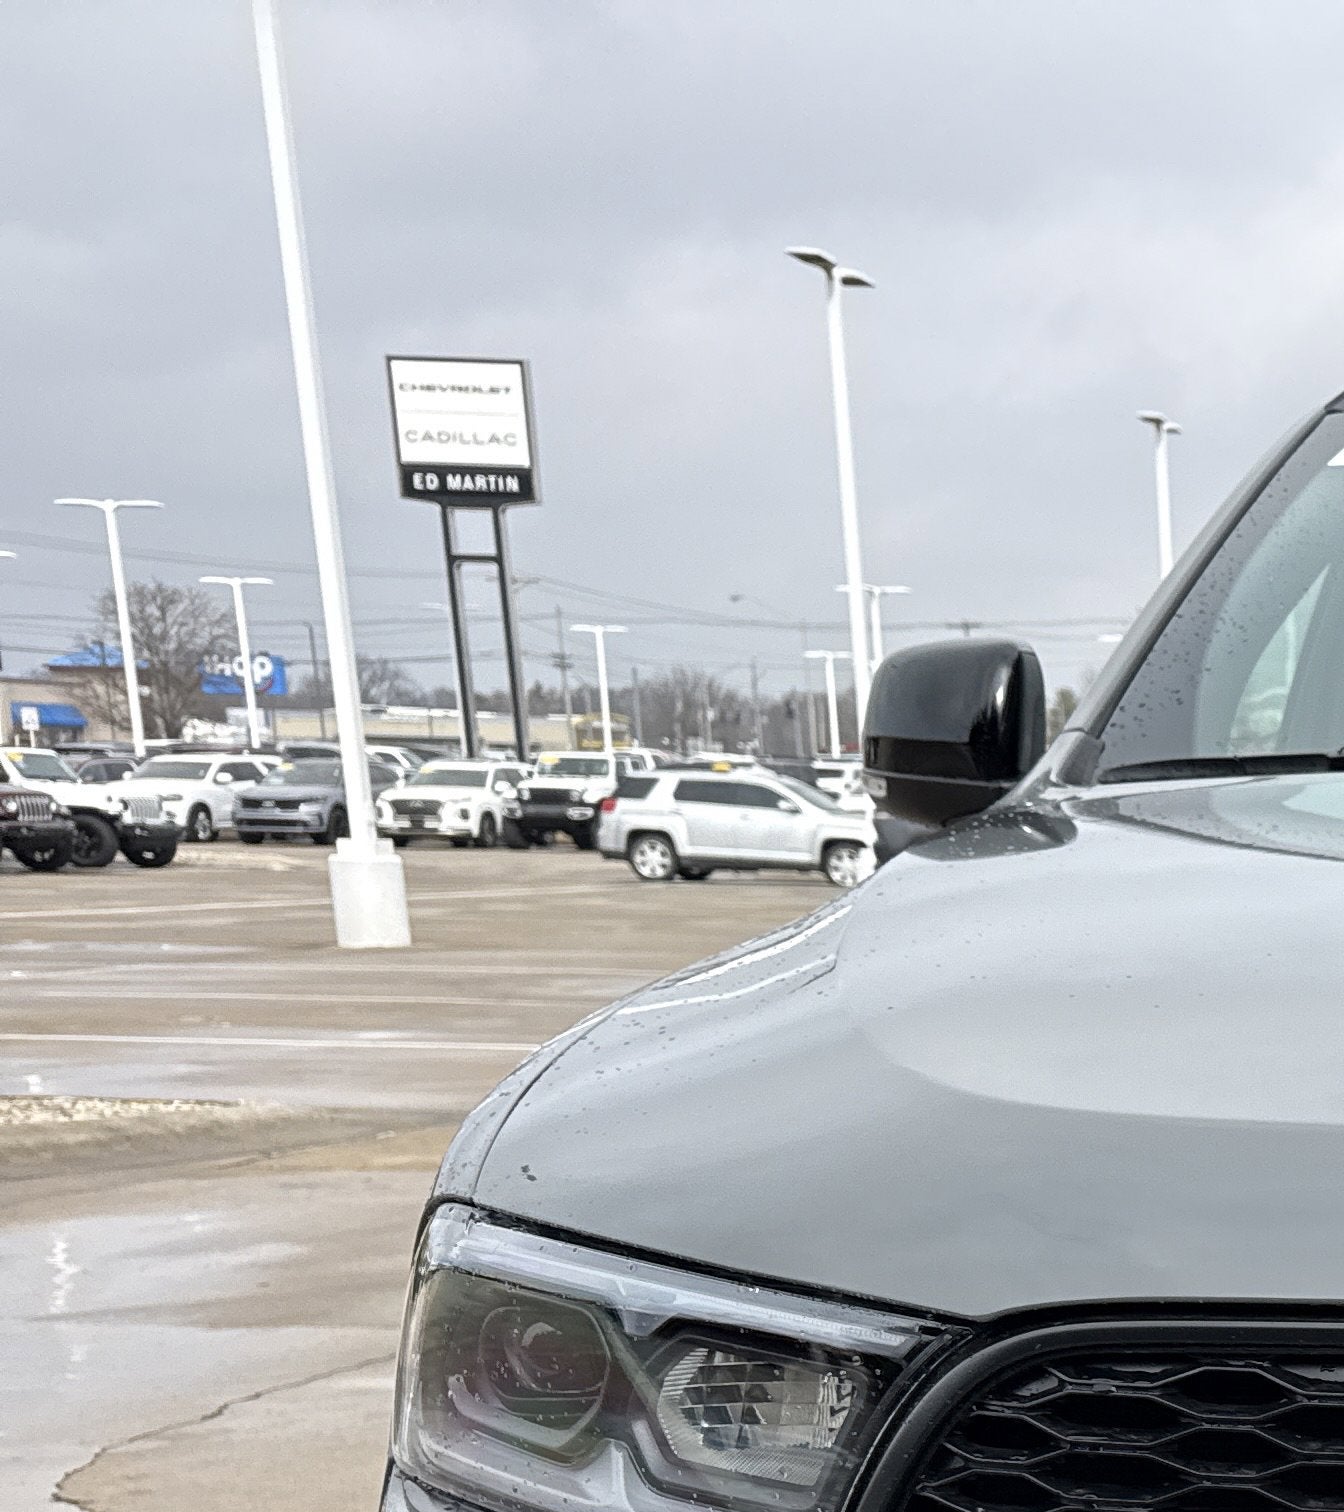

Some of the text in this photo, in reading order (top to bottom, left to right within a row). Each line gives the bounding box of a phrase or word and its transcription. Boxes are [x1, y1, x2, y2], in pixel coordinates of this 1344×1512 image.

[404, 429, 517, 447] CADILLAC
[412, 472, 520, 493] ED MARTIN
